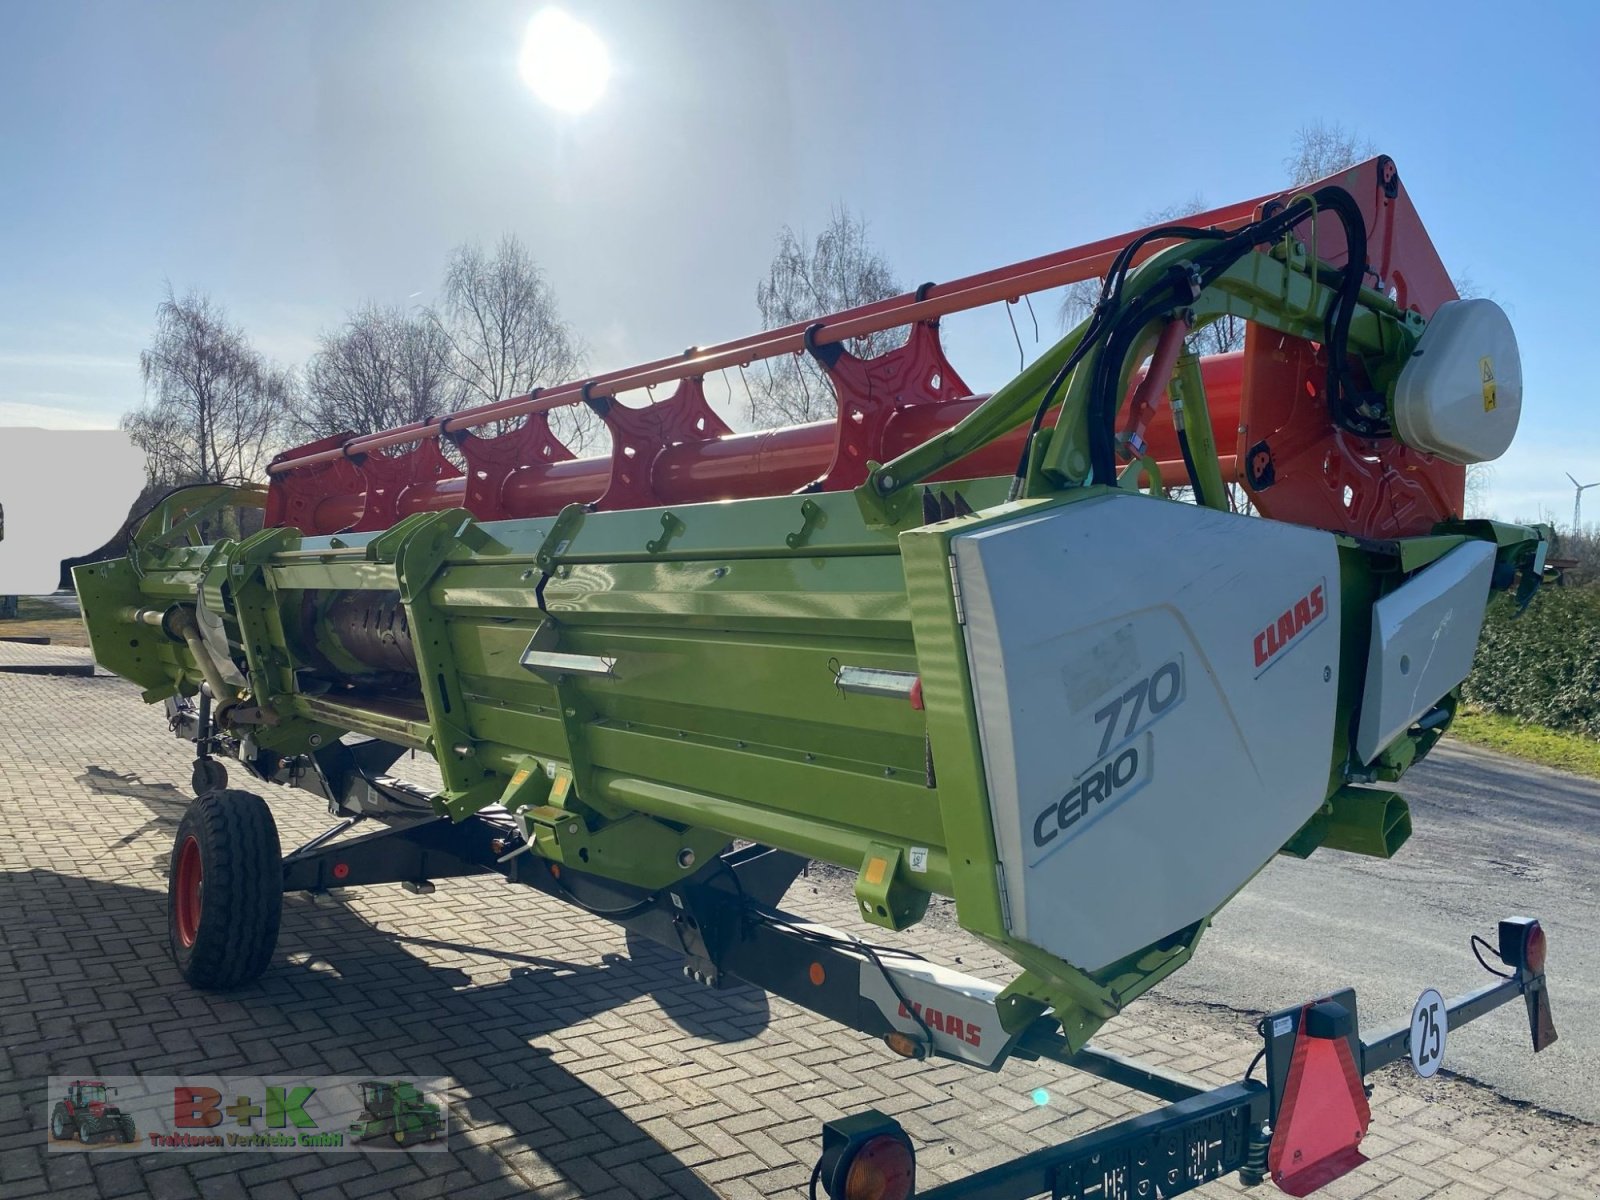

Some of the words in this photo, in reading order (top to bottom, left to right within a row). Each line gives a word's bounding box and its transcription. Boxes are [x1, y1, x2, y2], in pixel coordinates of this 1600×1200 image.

[1253, 584, 1324, 668] CLAAS
[1094, 662, 1181, 758] 770
[1033, 748, 1138, 847] CERIO
[1419, 1002, 1440, 1066] 25
